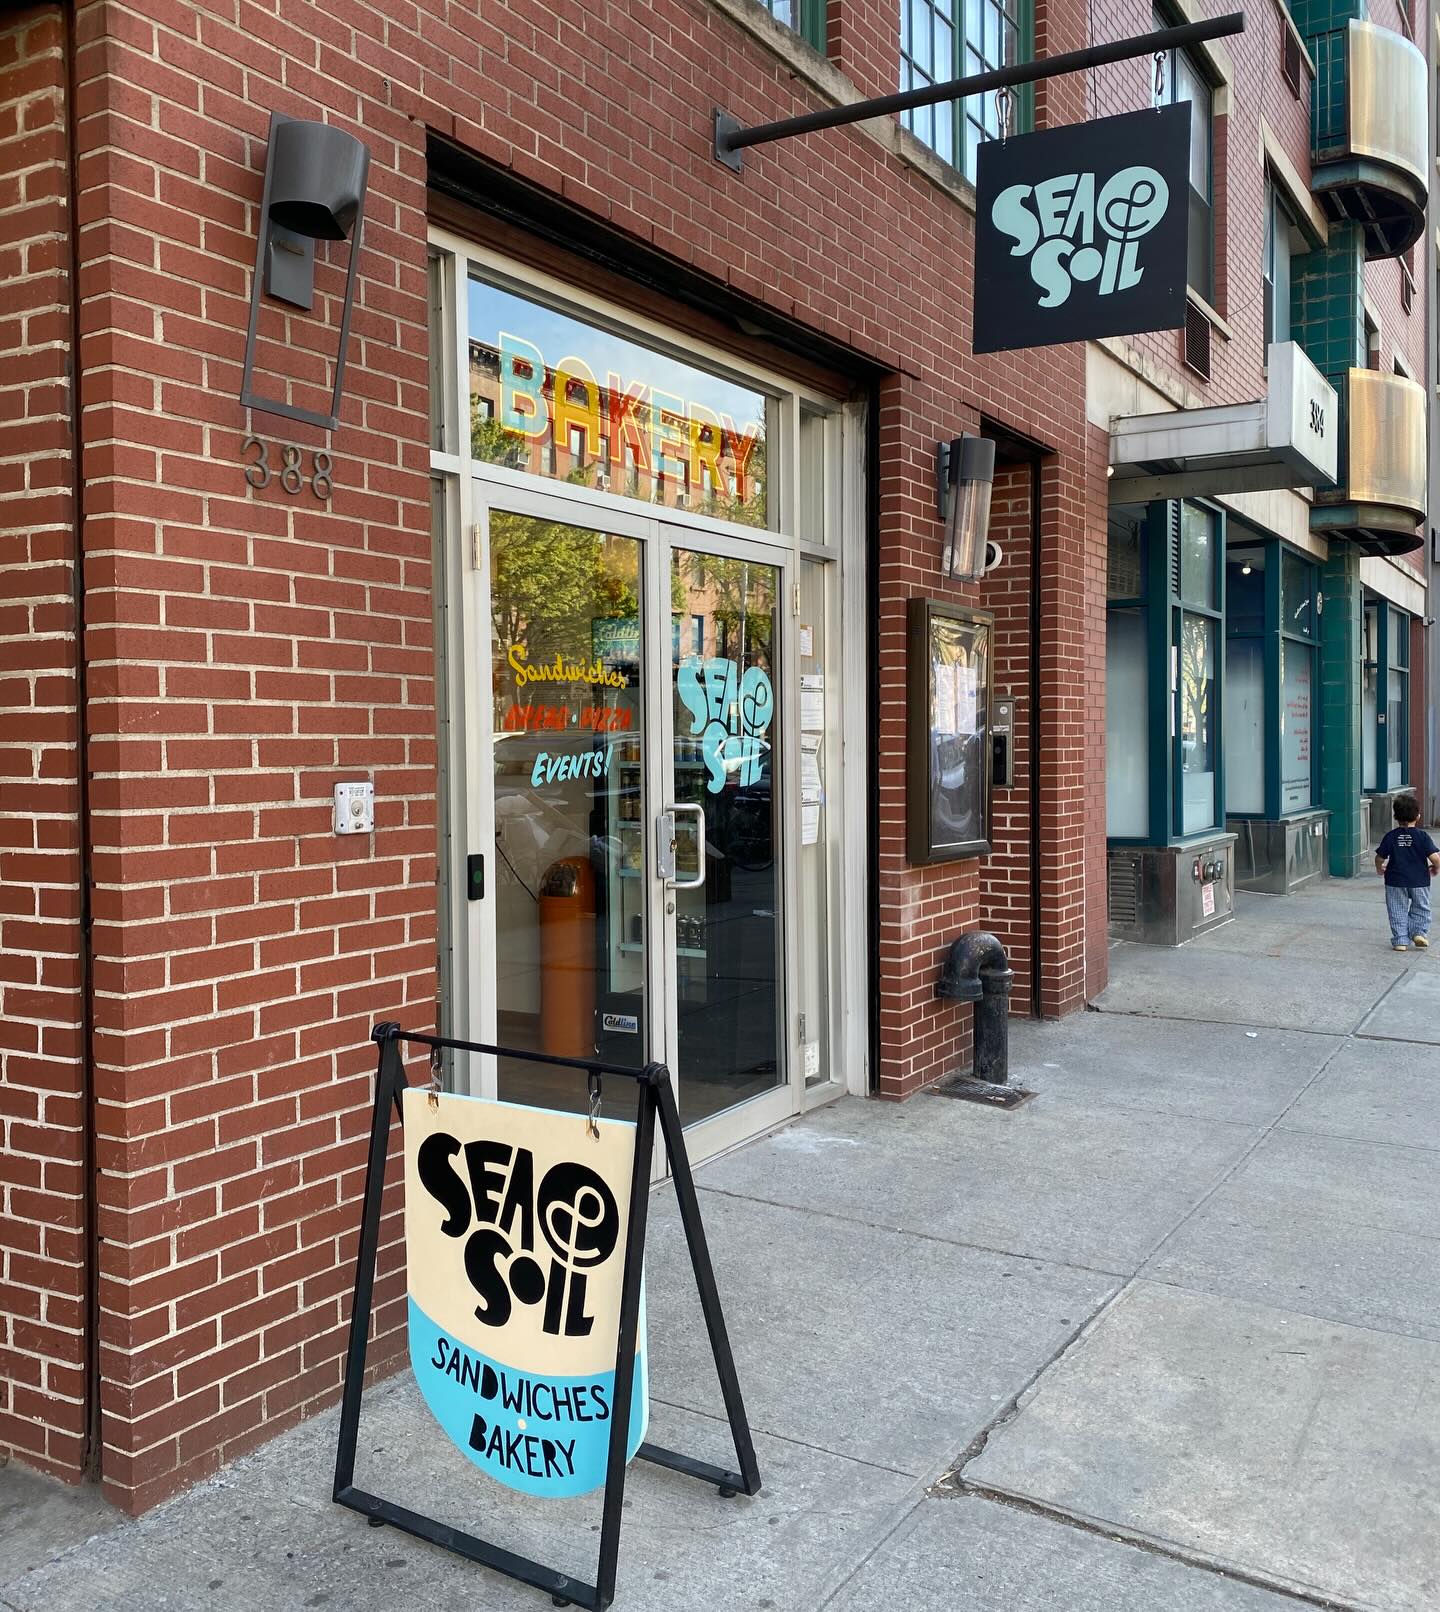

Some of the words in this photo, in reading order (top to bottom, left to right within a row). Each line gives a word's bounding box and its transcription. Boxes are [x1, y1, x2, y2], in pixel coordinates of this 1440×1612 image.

[992, 173, 1095, 256] SEA
[1031, 238, 1145, 308] SOIL
[499, 331, 757, 496] BAKERY
[1310, 398, 1324, 438] 384
[240, 435, 333, 500] 388
[508, 645, 627, 689] Sandwiches
[677, 656, 738, 735] SEA
[531, 743, 614, 788] EVENTS!
[702, 721, 764, 794] SOIL
[604, 1015, 637, 1030] Coldline
[417, 1132, 534, 1254] SEA
[464, 1228, 595, 1337] SOIL
[431, 1337, 610, 1422] SANDWICHES
[469, 1413, 576, 1478] BAKERY
